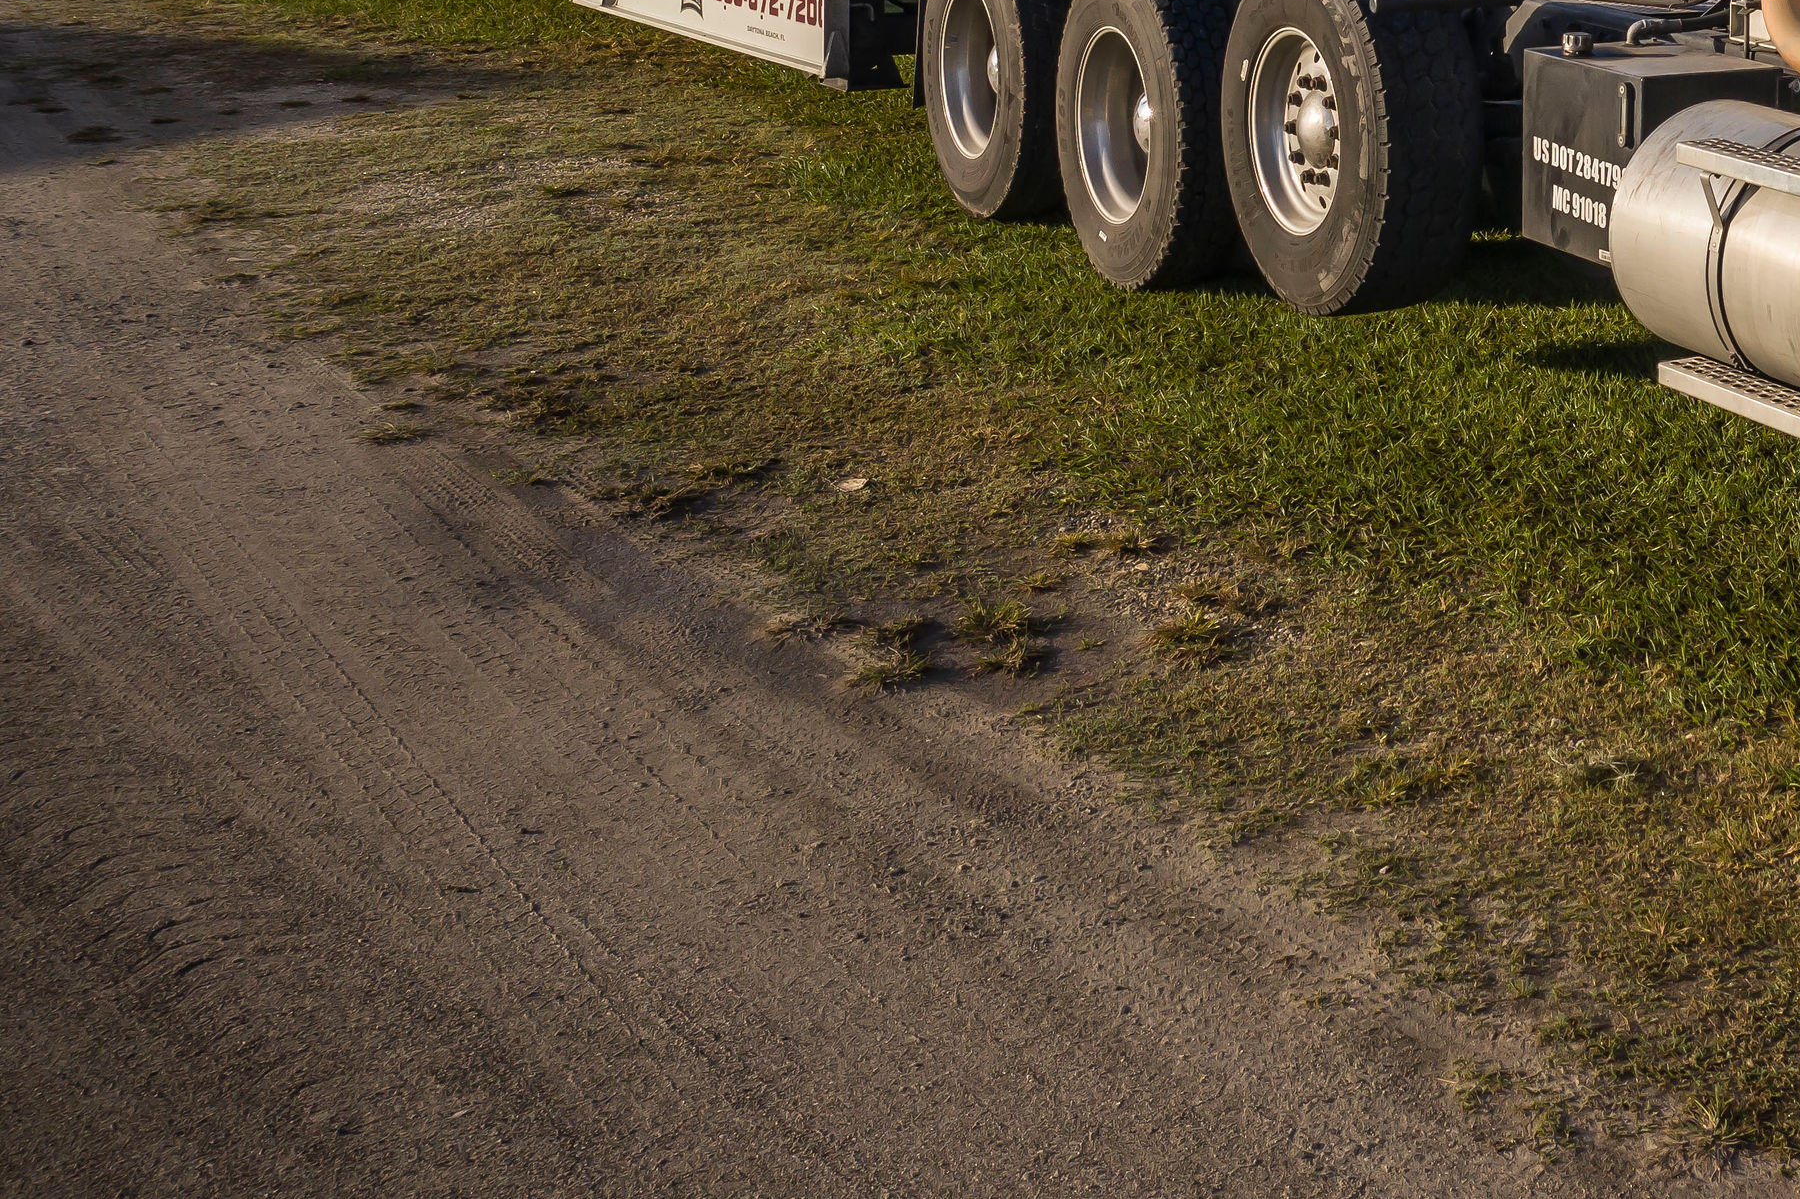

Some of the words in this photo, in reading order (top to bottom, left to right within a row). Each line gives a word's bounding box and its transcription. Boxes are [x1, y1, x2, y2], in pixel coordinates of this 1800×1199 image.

[1533, 135, 1550, 164] US
[1551, 142, 1575, 173] DOT
[1575, 151, 1626, 191] 284179
[1552, 184, 1571, 214] MC
[1572, 192, 1607, 229] 91018
